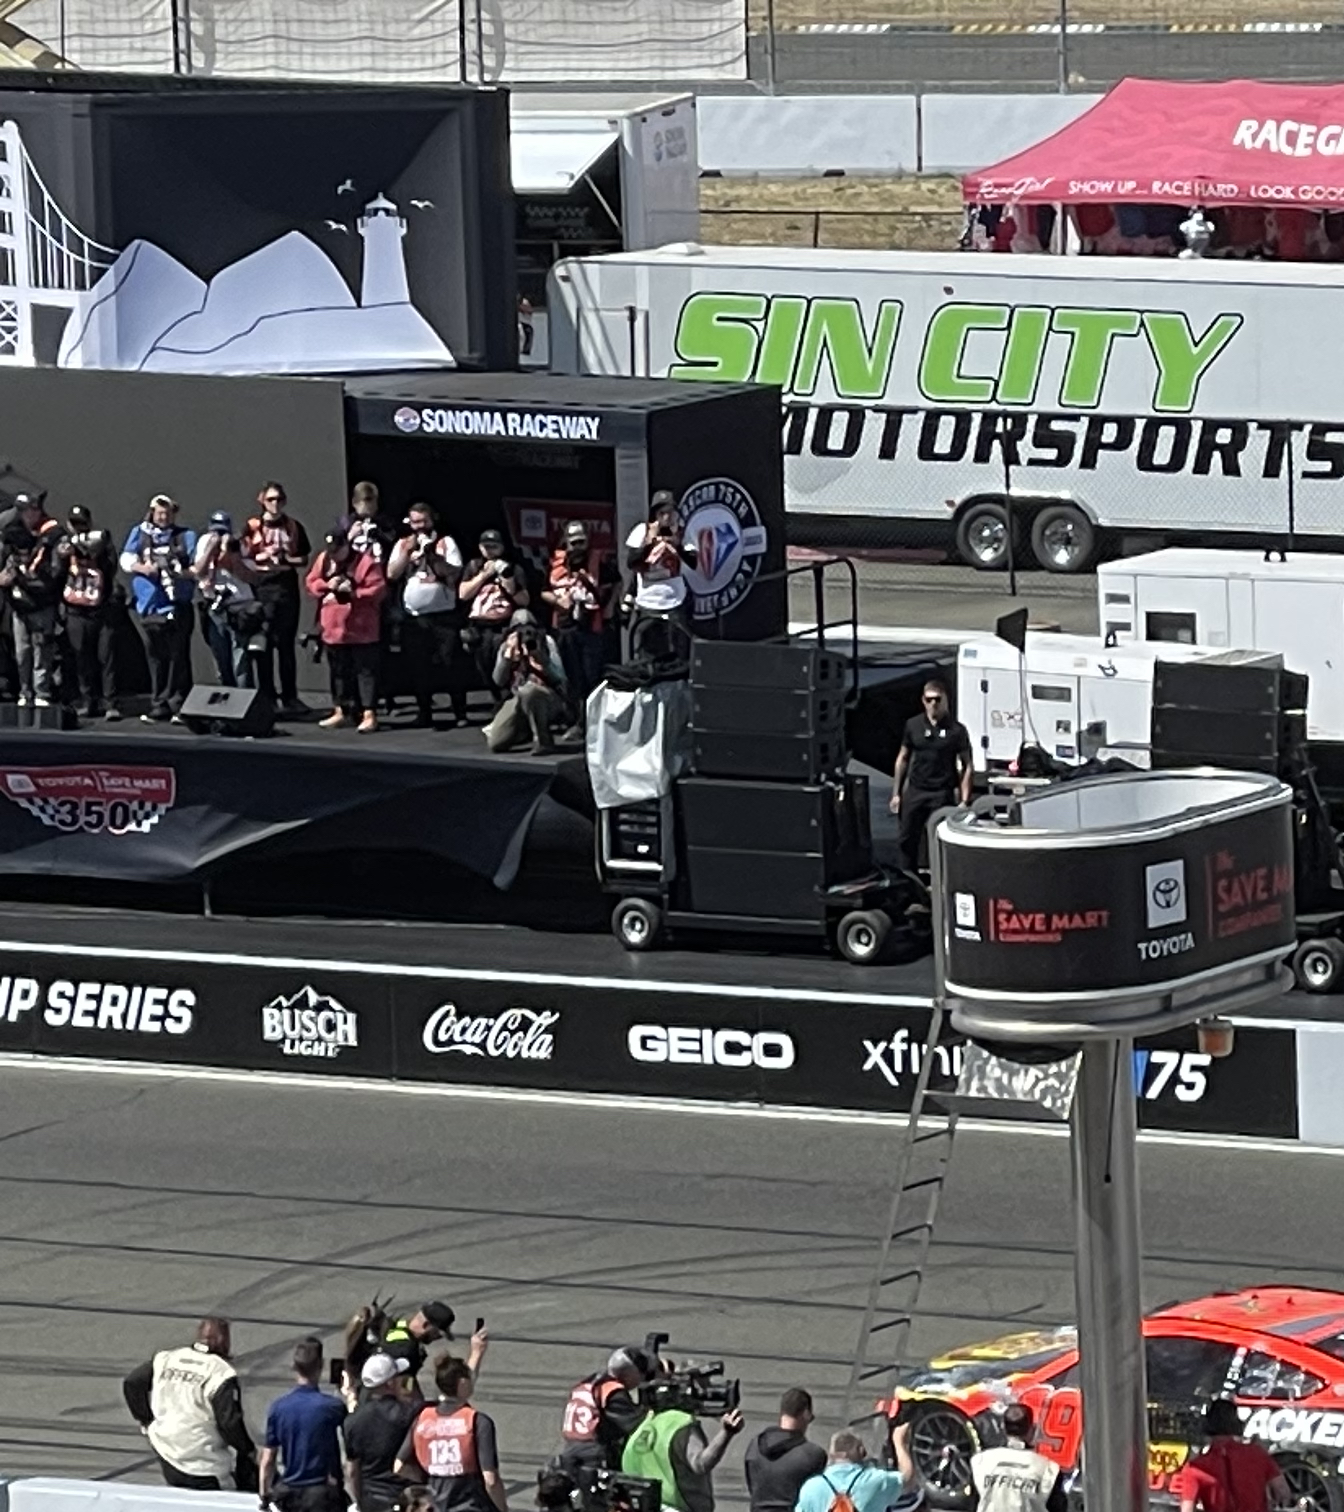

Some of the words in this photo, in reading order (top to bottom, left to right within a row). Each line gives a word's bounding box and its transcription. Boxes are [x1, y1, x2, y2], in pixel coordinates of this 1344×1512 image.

[1151, 182, 1192, 196] RACE
[1250, 185, 1295, 199] LOOK
[669, 291, 904, 400] SIN
[919, 302, 1244, 414] CITY
[421, 407, 506, 437] SONOMA
[506, 412, 600, 441] RACEWAY
[55, 797, 132, 835] 350
[1216, 875, 1269, 912] SAVE
[998, 911, 1047, 932] SAVE
[1056, 909, 1111, 931] MART
[1137, 930, 1196, 962] TOYOTA
[43, 979, 197, 1035] SERIES
[262, 1005, 358, 1047] BUSCH
[283, 1040, 341, 1058] LIGHT
[627, 1024, 796, 1070] GEICO
[862, 1028, 964, 1087] xfini
[1143, 1049, 1213, 1103] 75
